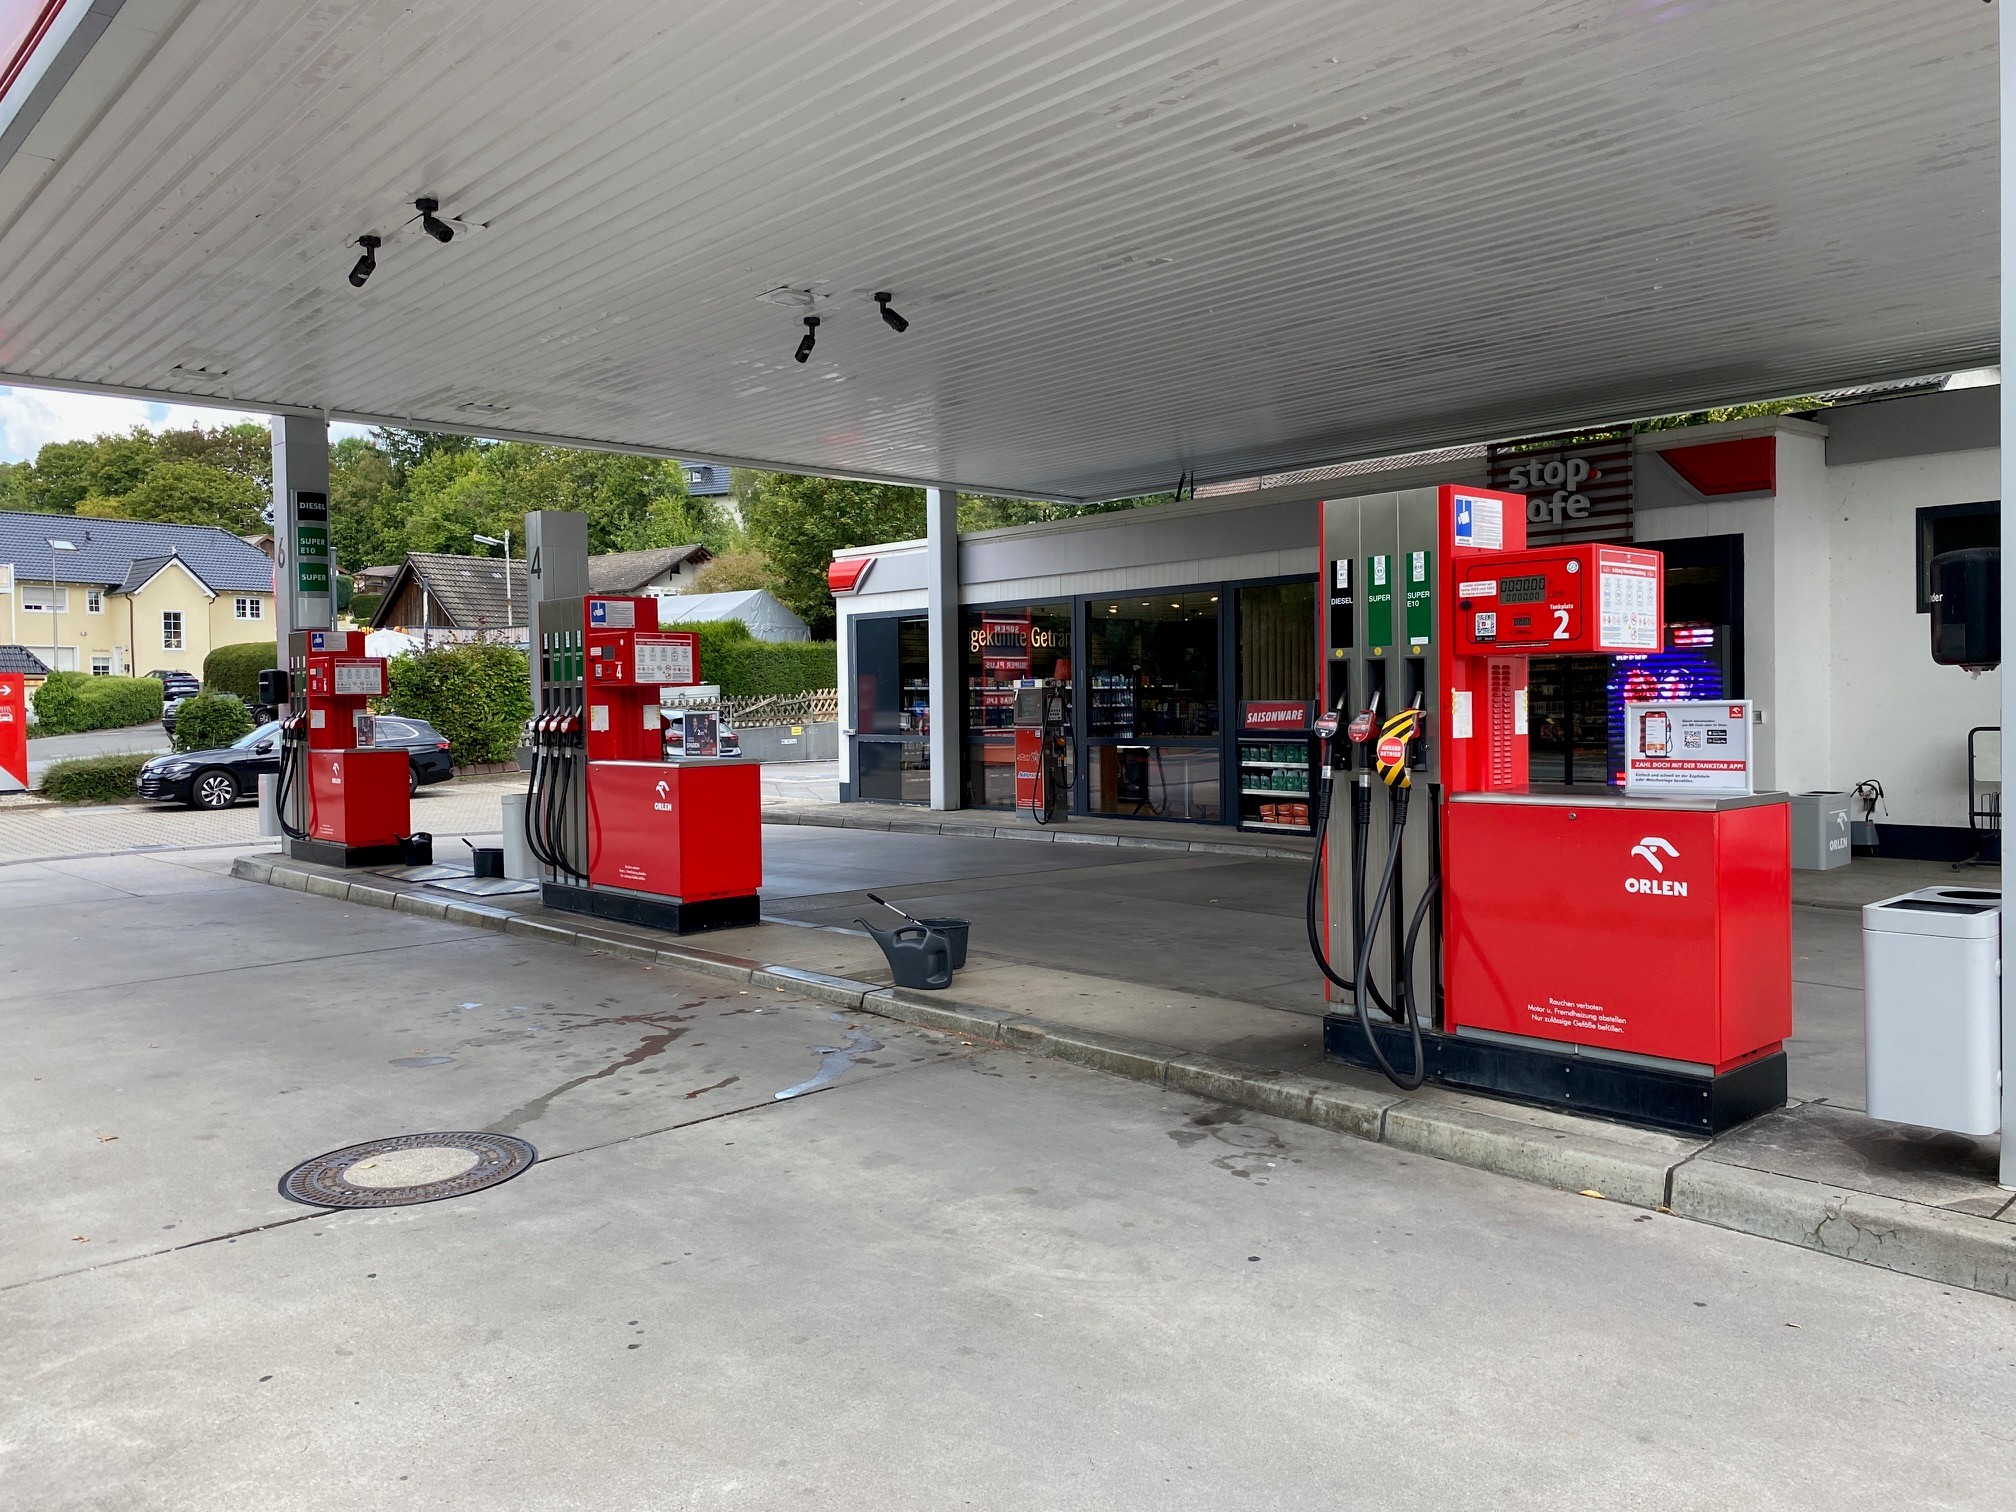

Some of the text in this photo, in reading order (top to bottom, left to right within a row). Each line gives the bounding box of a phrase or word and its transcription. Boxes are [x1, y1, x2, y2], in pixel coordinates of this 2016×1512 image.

[299, 501, 326, 511] DIESEL
[1527, 490, 1590, 524] afe
[299, 537, 326, 546] SUPER
[278, 537, 285, 569] 6
[530, 546, 542, 580] 4
[301, 573, 327, 581] SUPER
[1331, 597, 1353, 605] DIESEL
[1368, 594, 1391, 602] SUPER
[1407, 590, 1430, 599] SUPER
[1553, 610, 1570, 639] 2
[616, 664, 622, 680] 4
[1013, 689, 1018, 701] 7
[1247, 709, 1304, 723] SAISONWARE
[654, 802, 672, 811] ORLEN
[1829, 837, 1848, 851] ORLEN
[1625, 878, 1688, 897] ORLEN
[1549, 997, 1603, 1011] Rauchen verboten
[1528, 1004, 1545, 1012] Motor
[1554, 1008, 1597, 1021] Fremdheizung
[1598, 1014, 1627, 1024] abstellen
[1544, 1016, 1572, 1026] zulässige
[1573, 1019, 1596, 1030] Gefäße
[1597, 1023, 1624, 1033] befüllen.
